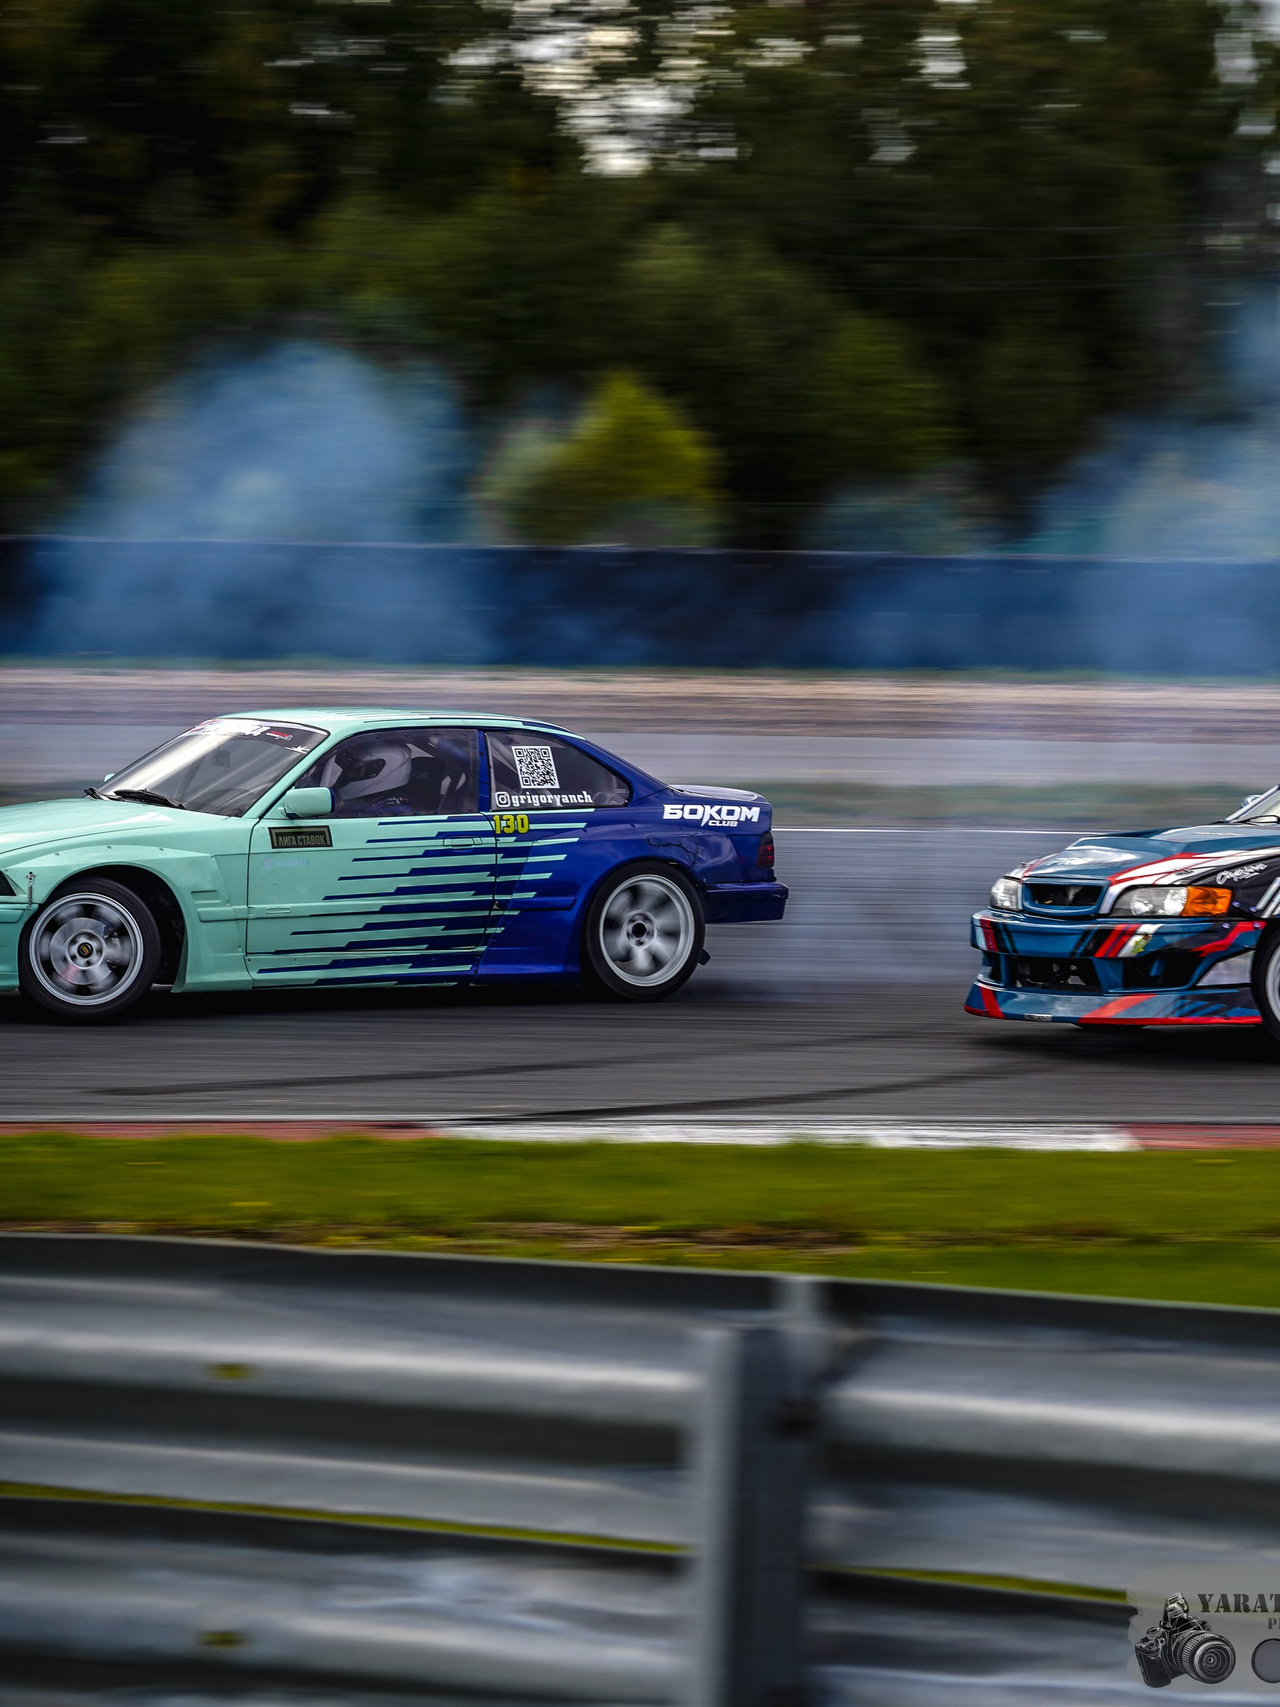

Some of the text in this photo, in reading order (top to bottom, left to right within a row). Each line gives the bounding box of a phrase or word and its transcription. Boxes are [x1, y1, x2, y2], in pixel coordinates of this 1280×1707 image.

[511, 791, 593, 807] grigoryanch
[493, 814, 530, 834] 130
[663, 804, 760, 827] БОКОМ
[278, 835, 326, 846] ЛИГА СТАВОК
